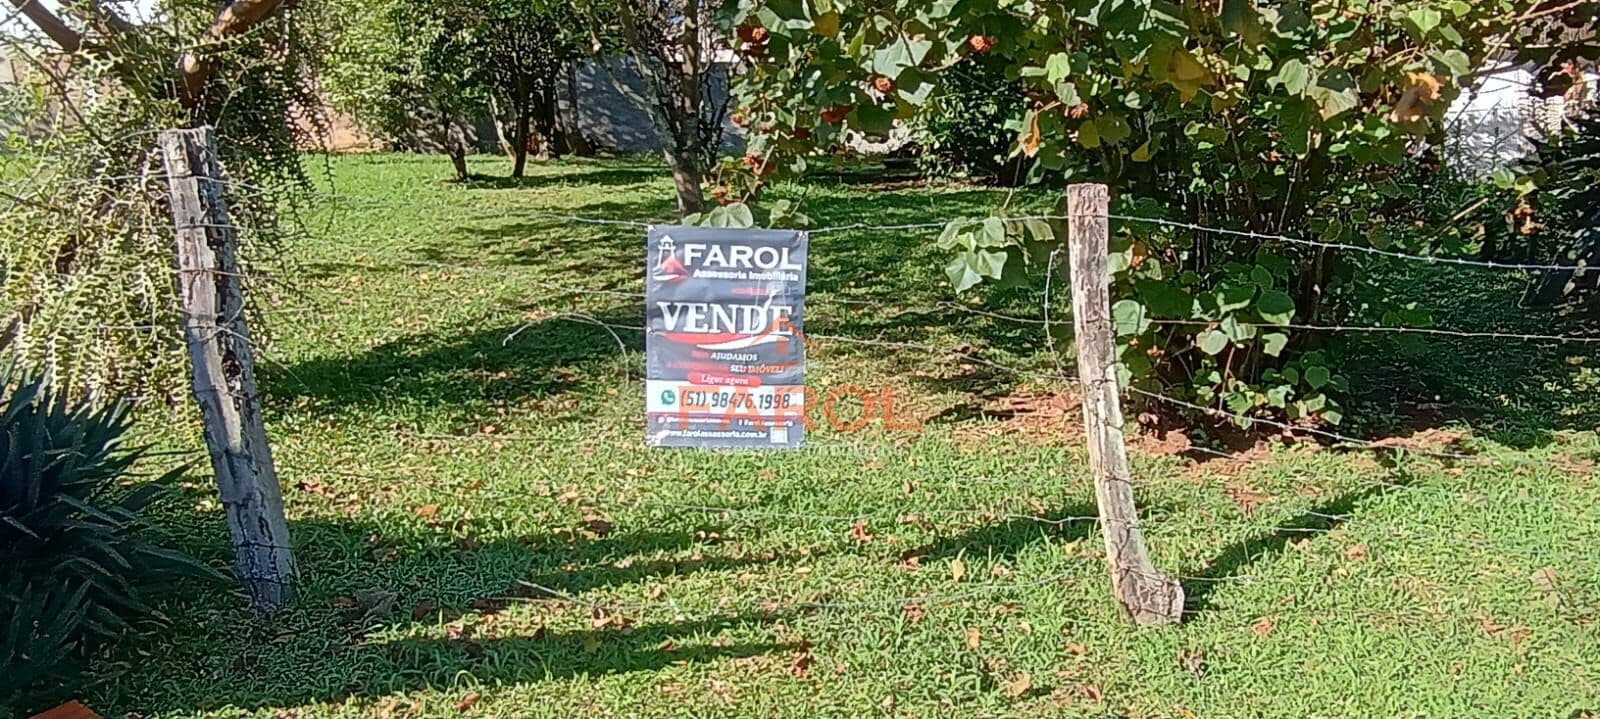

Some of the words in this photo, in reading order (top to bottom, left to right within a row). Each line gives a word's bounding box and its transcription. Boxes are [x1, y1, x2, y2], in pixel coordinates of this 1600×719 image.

[684, 243, 802, 271] FAROL
[693, 268, 747, 280] Assessoria
[656, 301, 793, 335] VENDE
[710, 352, 758, 361] AJUDAMOS
[680, 390, 706, 408] (51)
[711, 391, 791, 410] 98476.1998
